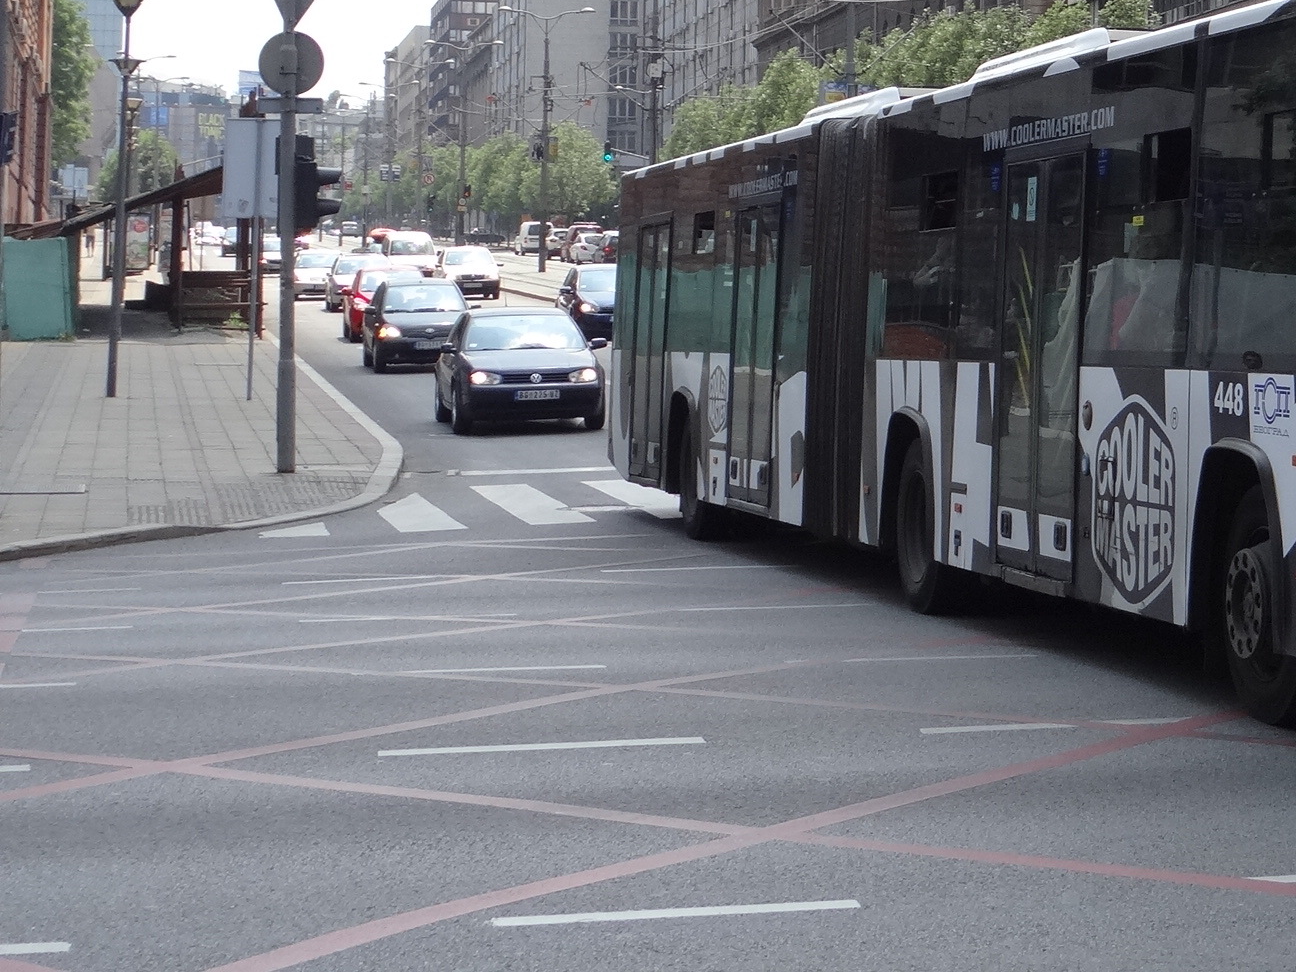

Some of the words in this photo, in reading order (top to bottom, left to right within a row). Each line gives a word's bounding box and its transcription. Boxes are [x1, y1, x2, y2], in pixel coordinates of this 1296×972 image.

[983, 106, 1115, 152] WWW.COOLERMASTER.COM
[1214, 381, 1243, 416] 448
[1098, 412, 1173, 507] COOLER
[1096, 499, 1173, 592] MASTER
